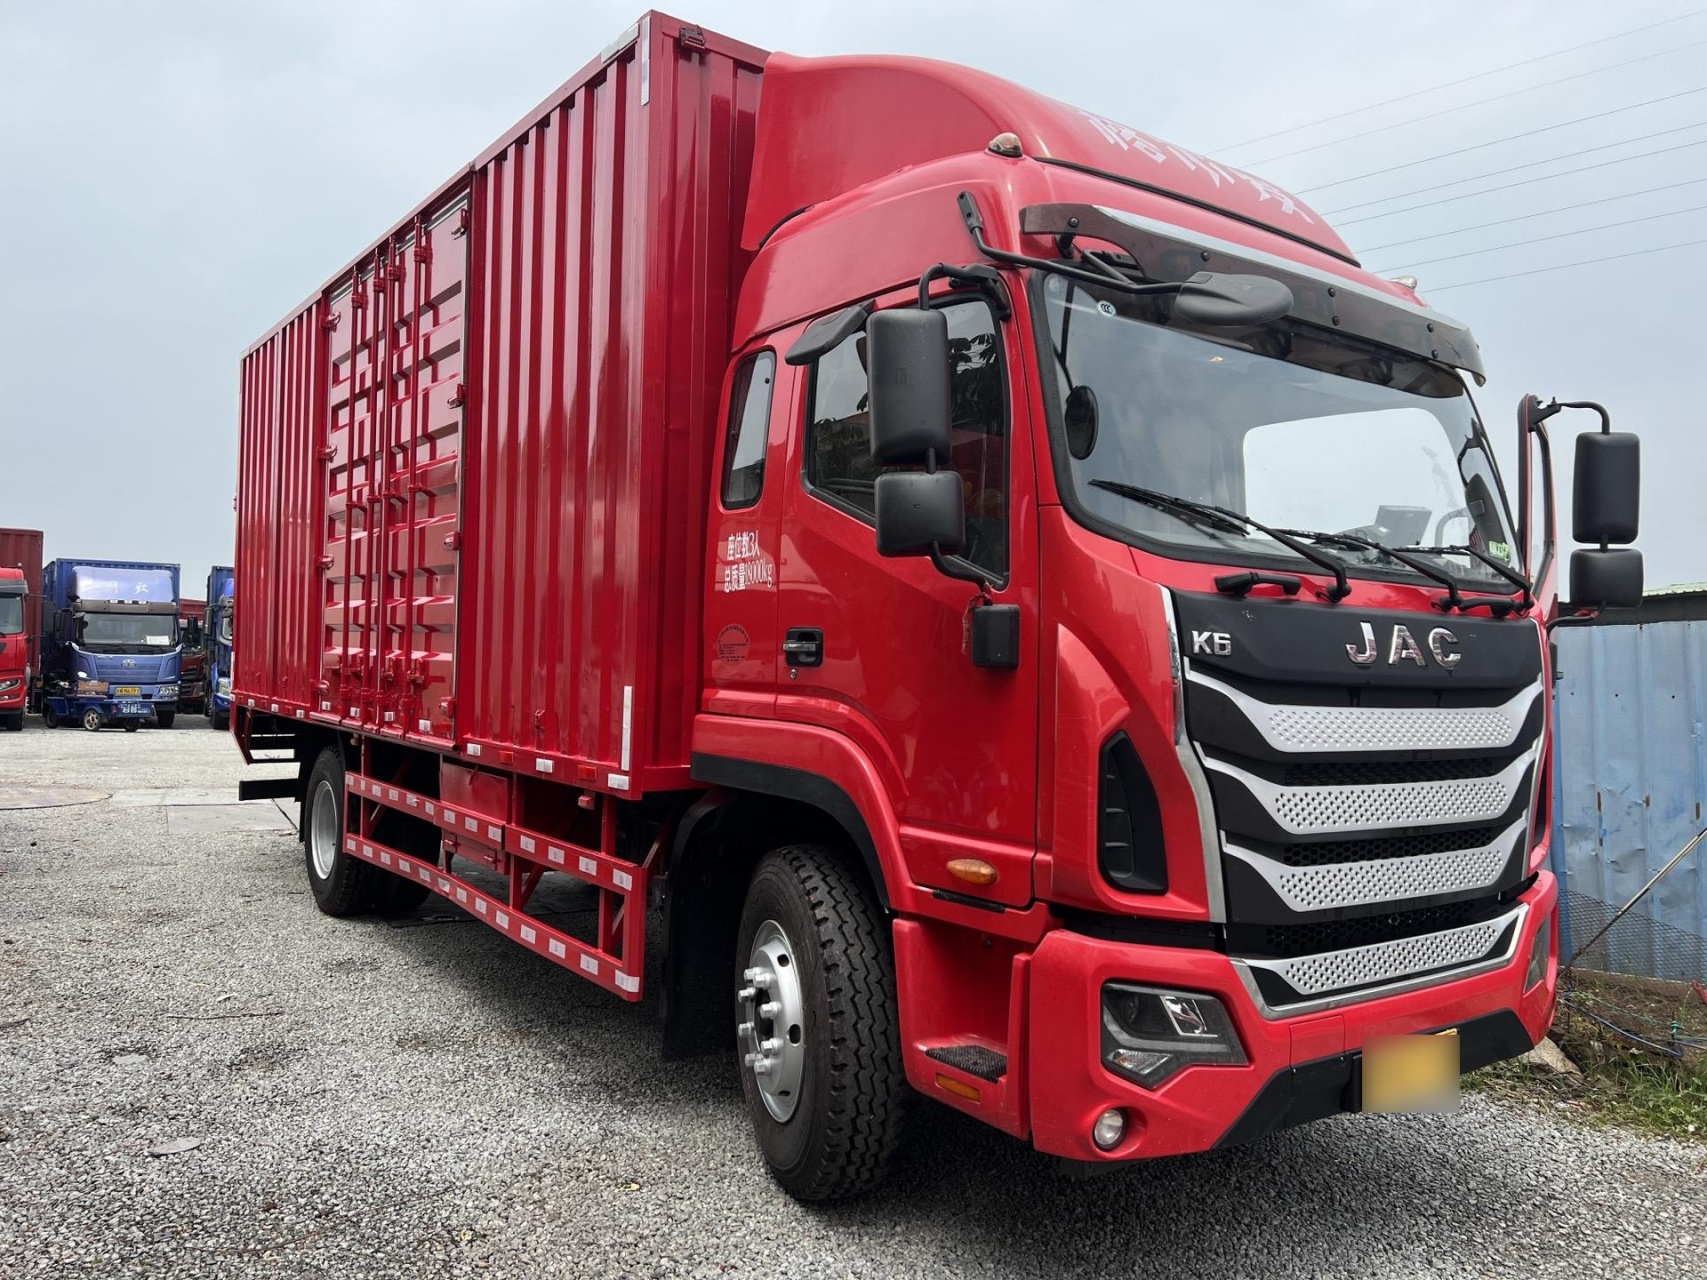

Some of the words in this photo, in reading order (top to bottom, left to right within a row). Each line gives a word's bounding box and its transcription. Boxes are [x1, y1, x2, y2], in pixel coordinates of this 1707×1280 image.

[727, 529, 760, 561] 座位数3人
[1191, 629, 1232, 657] K6
[1345, 621, 1462, 669] JAC
